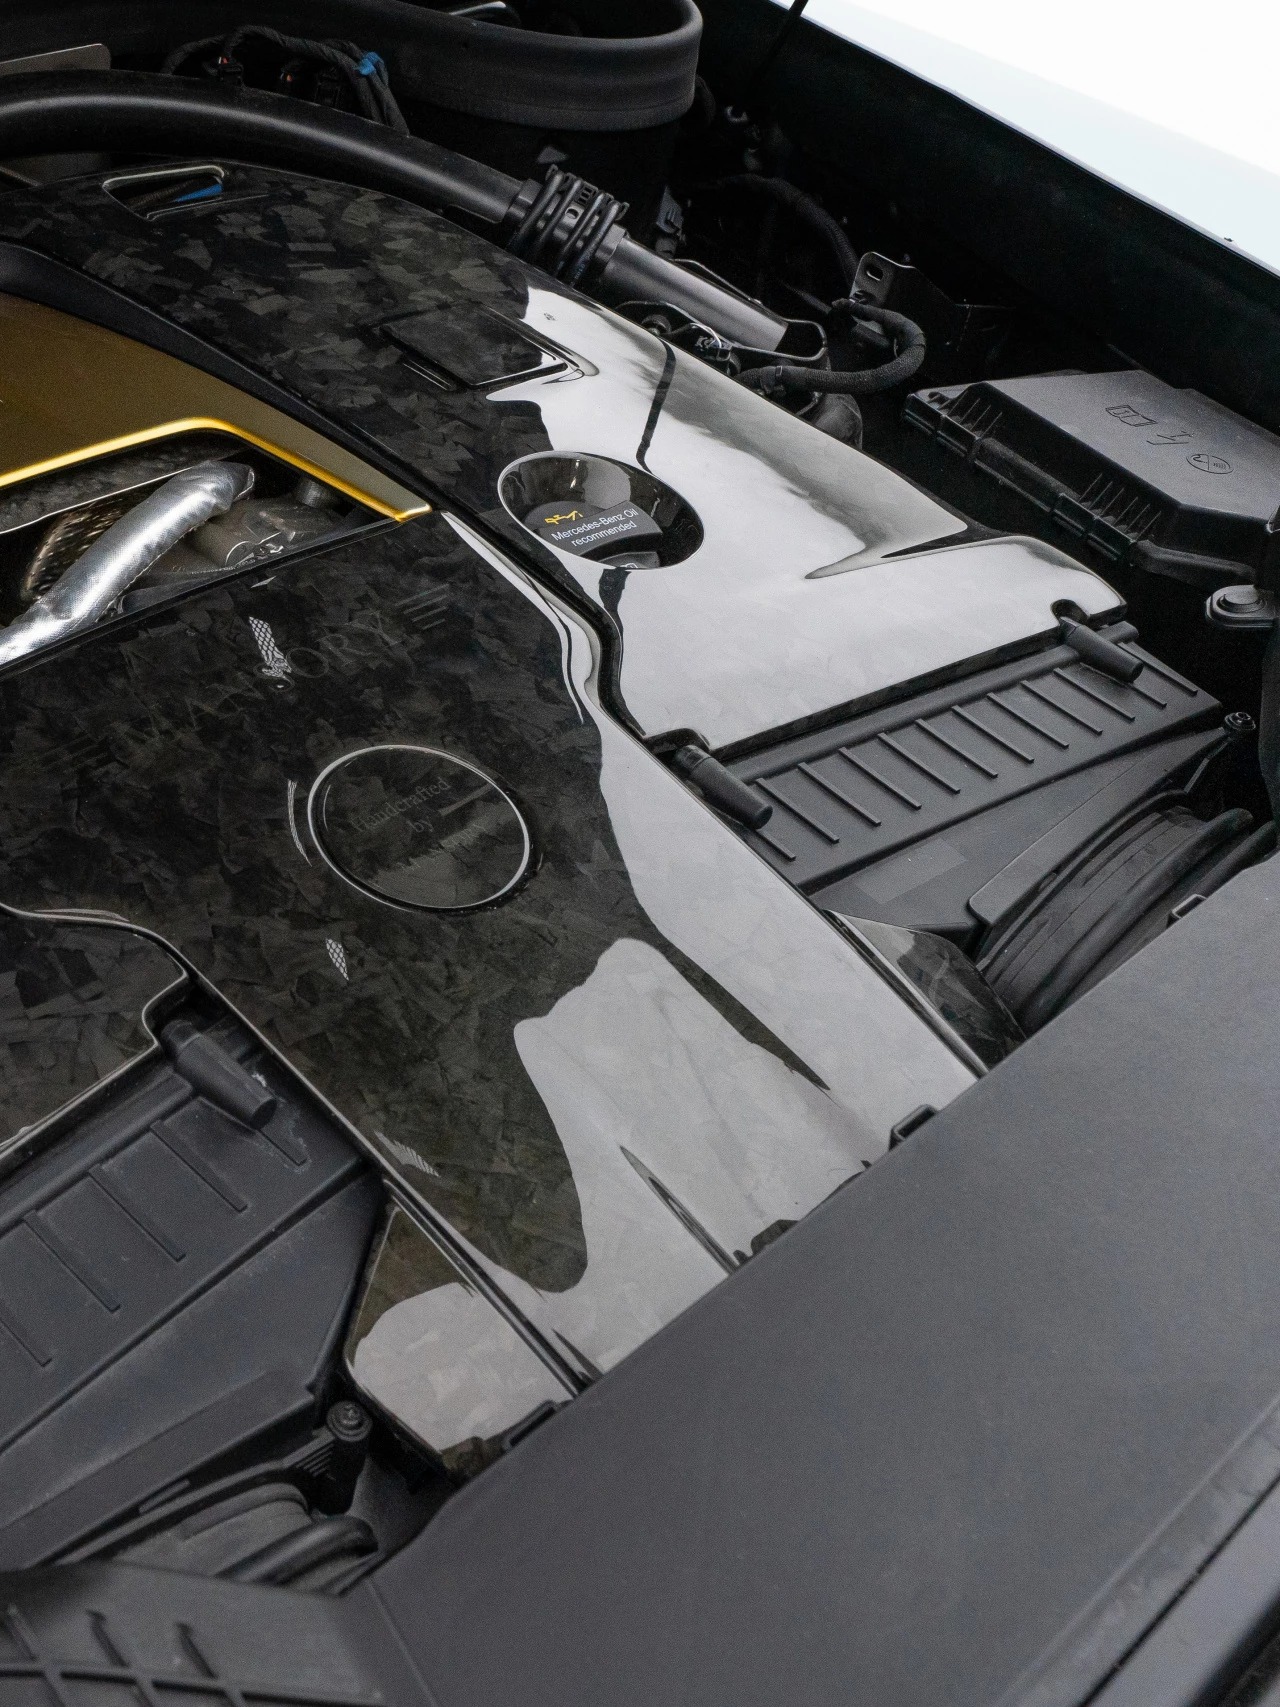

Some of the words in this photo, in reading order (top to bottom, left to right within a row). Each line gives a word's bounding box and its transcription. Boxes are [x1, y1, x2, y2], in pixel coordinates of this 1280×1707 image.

[551, 514, 625, 541] Mercedes-Benz
[625, 508, 639, 518] Oil
[571, 521, 637, 547] recommended
[349, 777, 451, 833] Handcrafted
[406, 817, 435, 834] by
